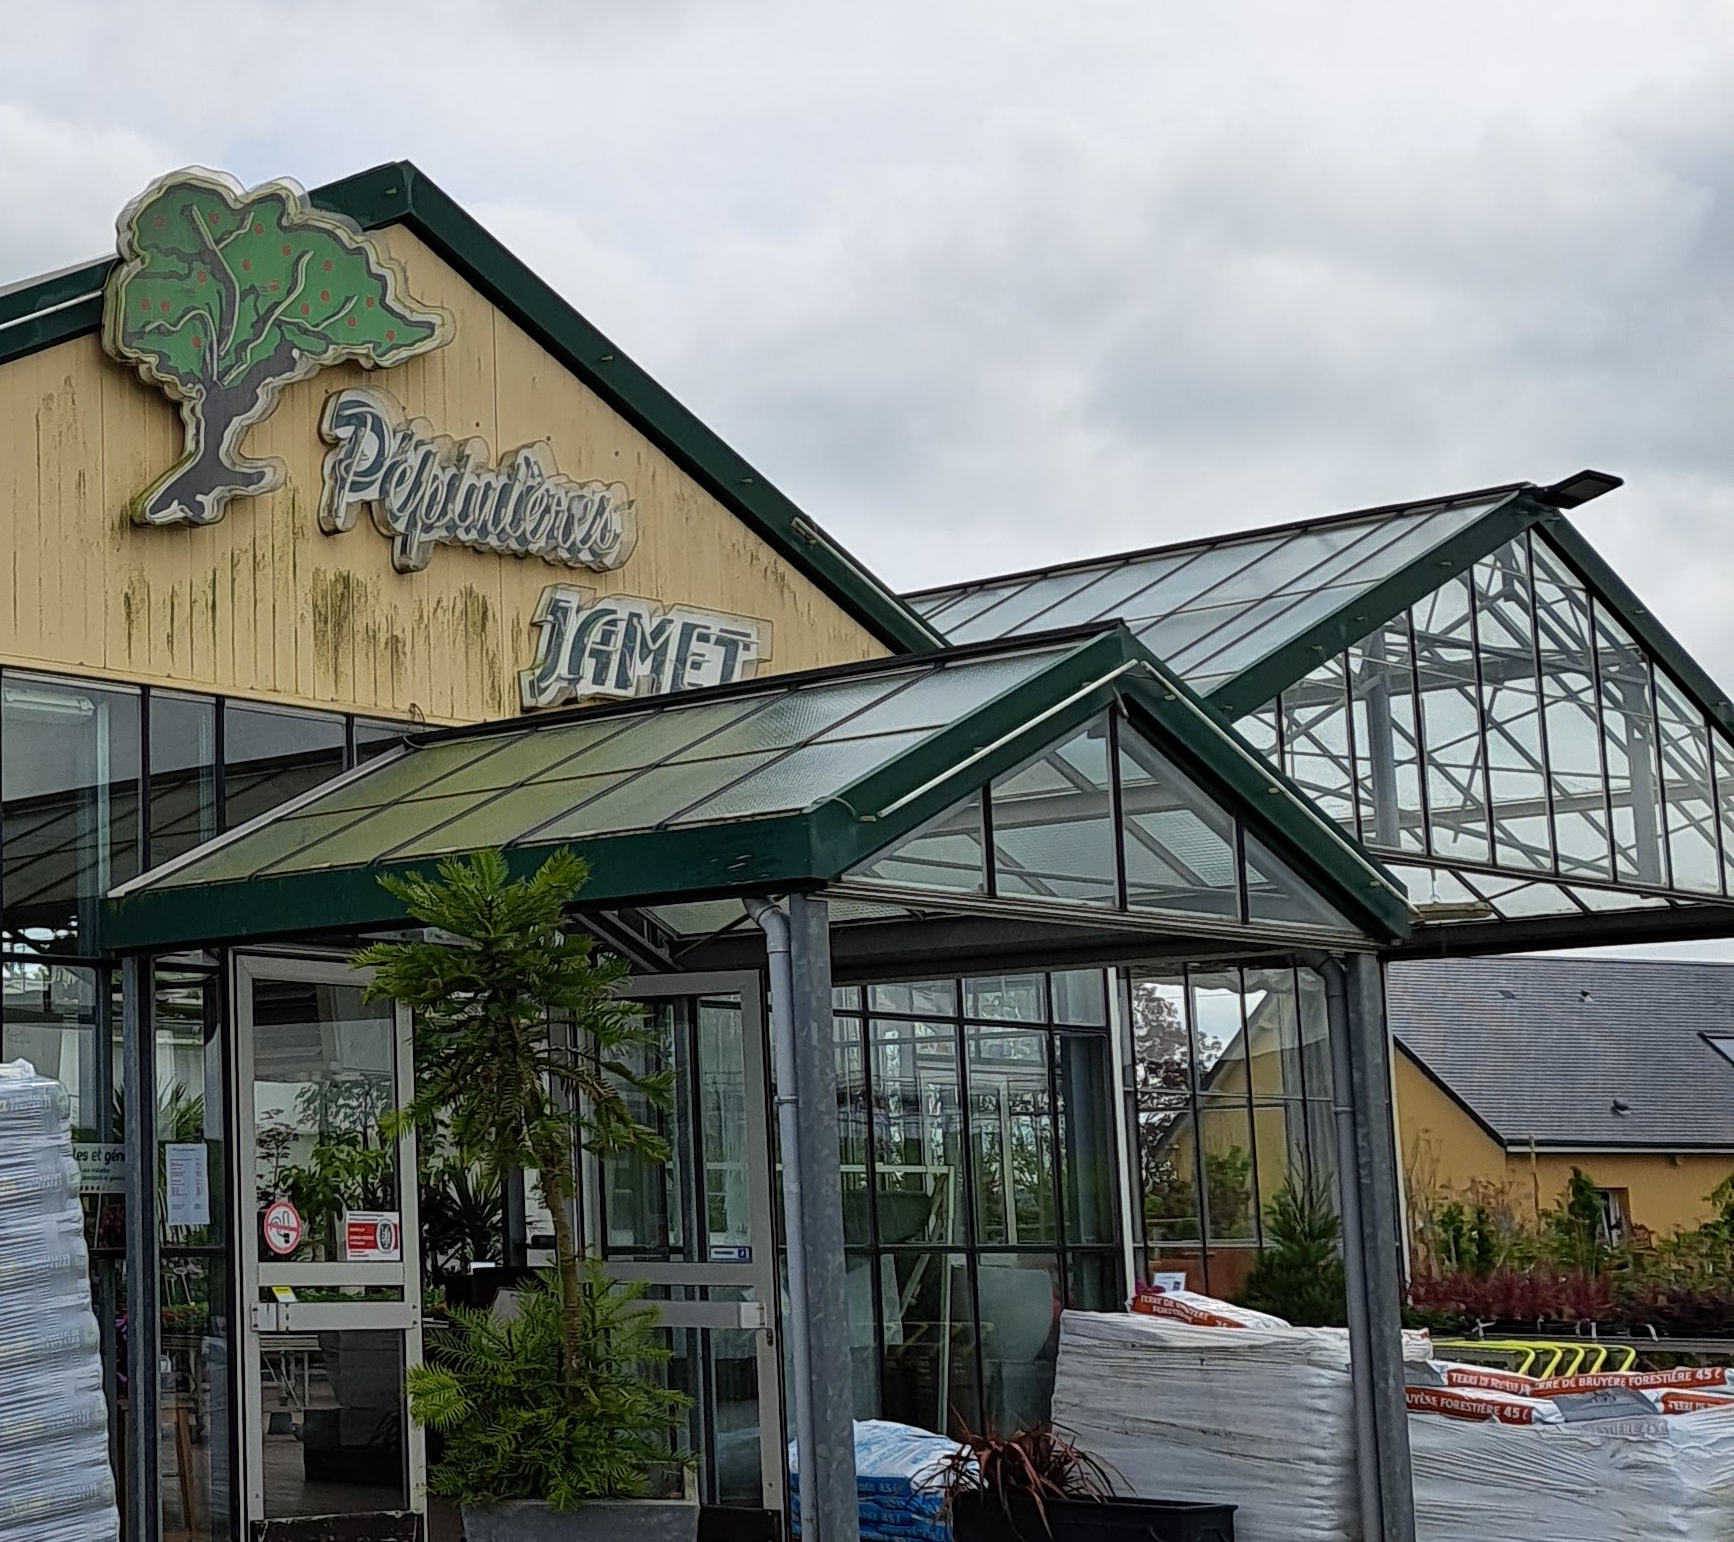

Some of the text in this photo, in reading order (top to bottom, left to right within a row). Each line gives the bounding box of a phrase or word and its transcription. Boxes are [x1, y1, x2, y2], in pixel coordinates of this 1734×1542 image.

[526, 591, 760, 701] JAMET
[1562, 1377, 1576, 1388] DE
[1695, 1369, 1712, 1380] 45
[1503, 1407, 1520, 1419] 45
